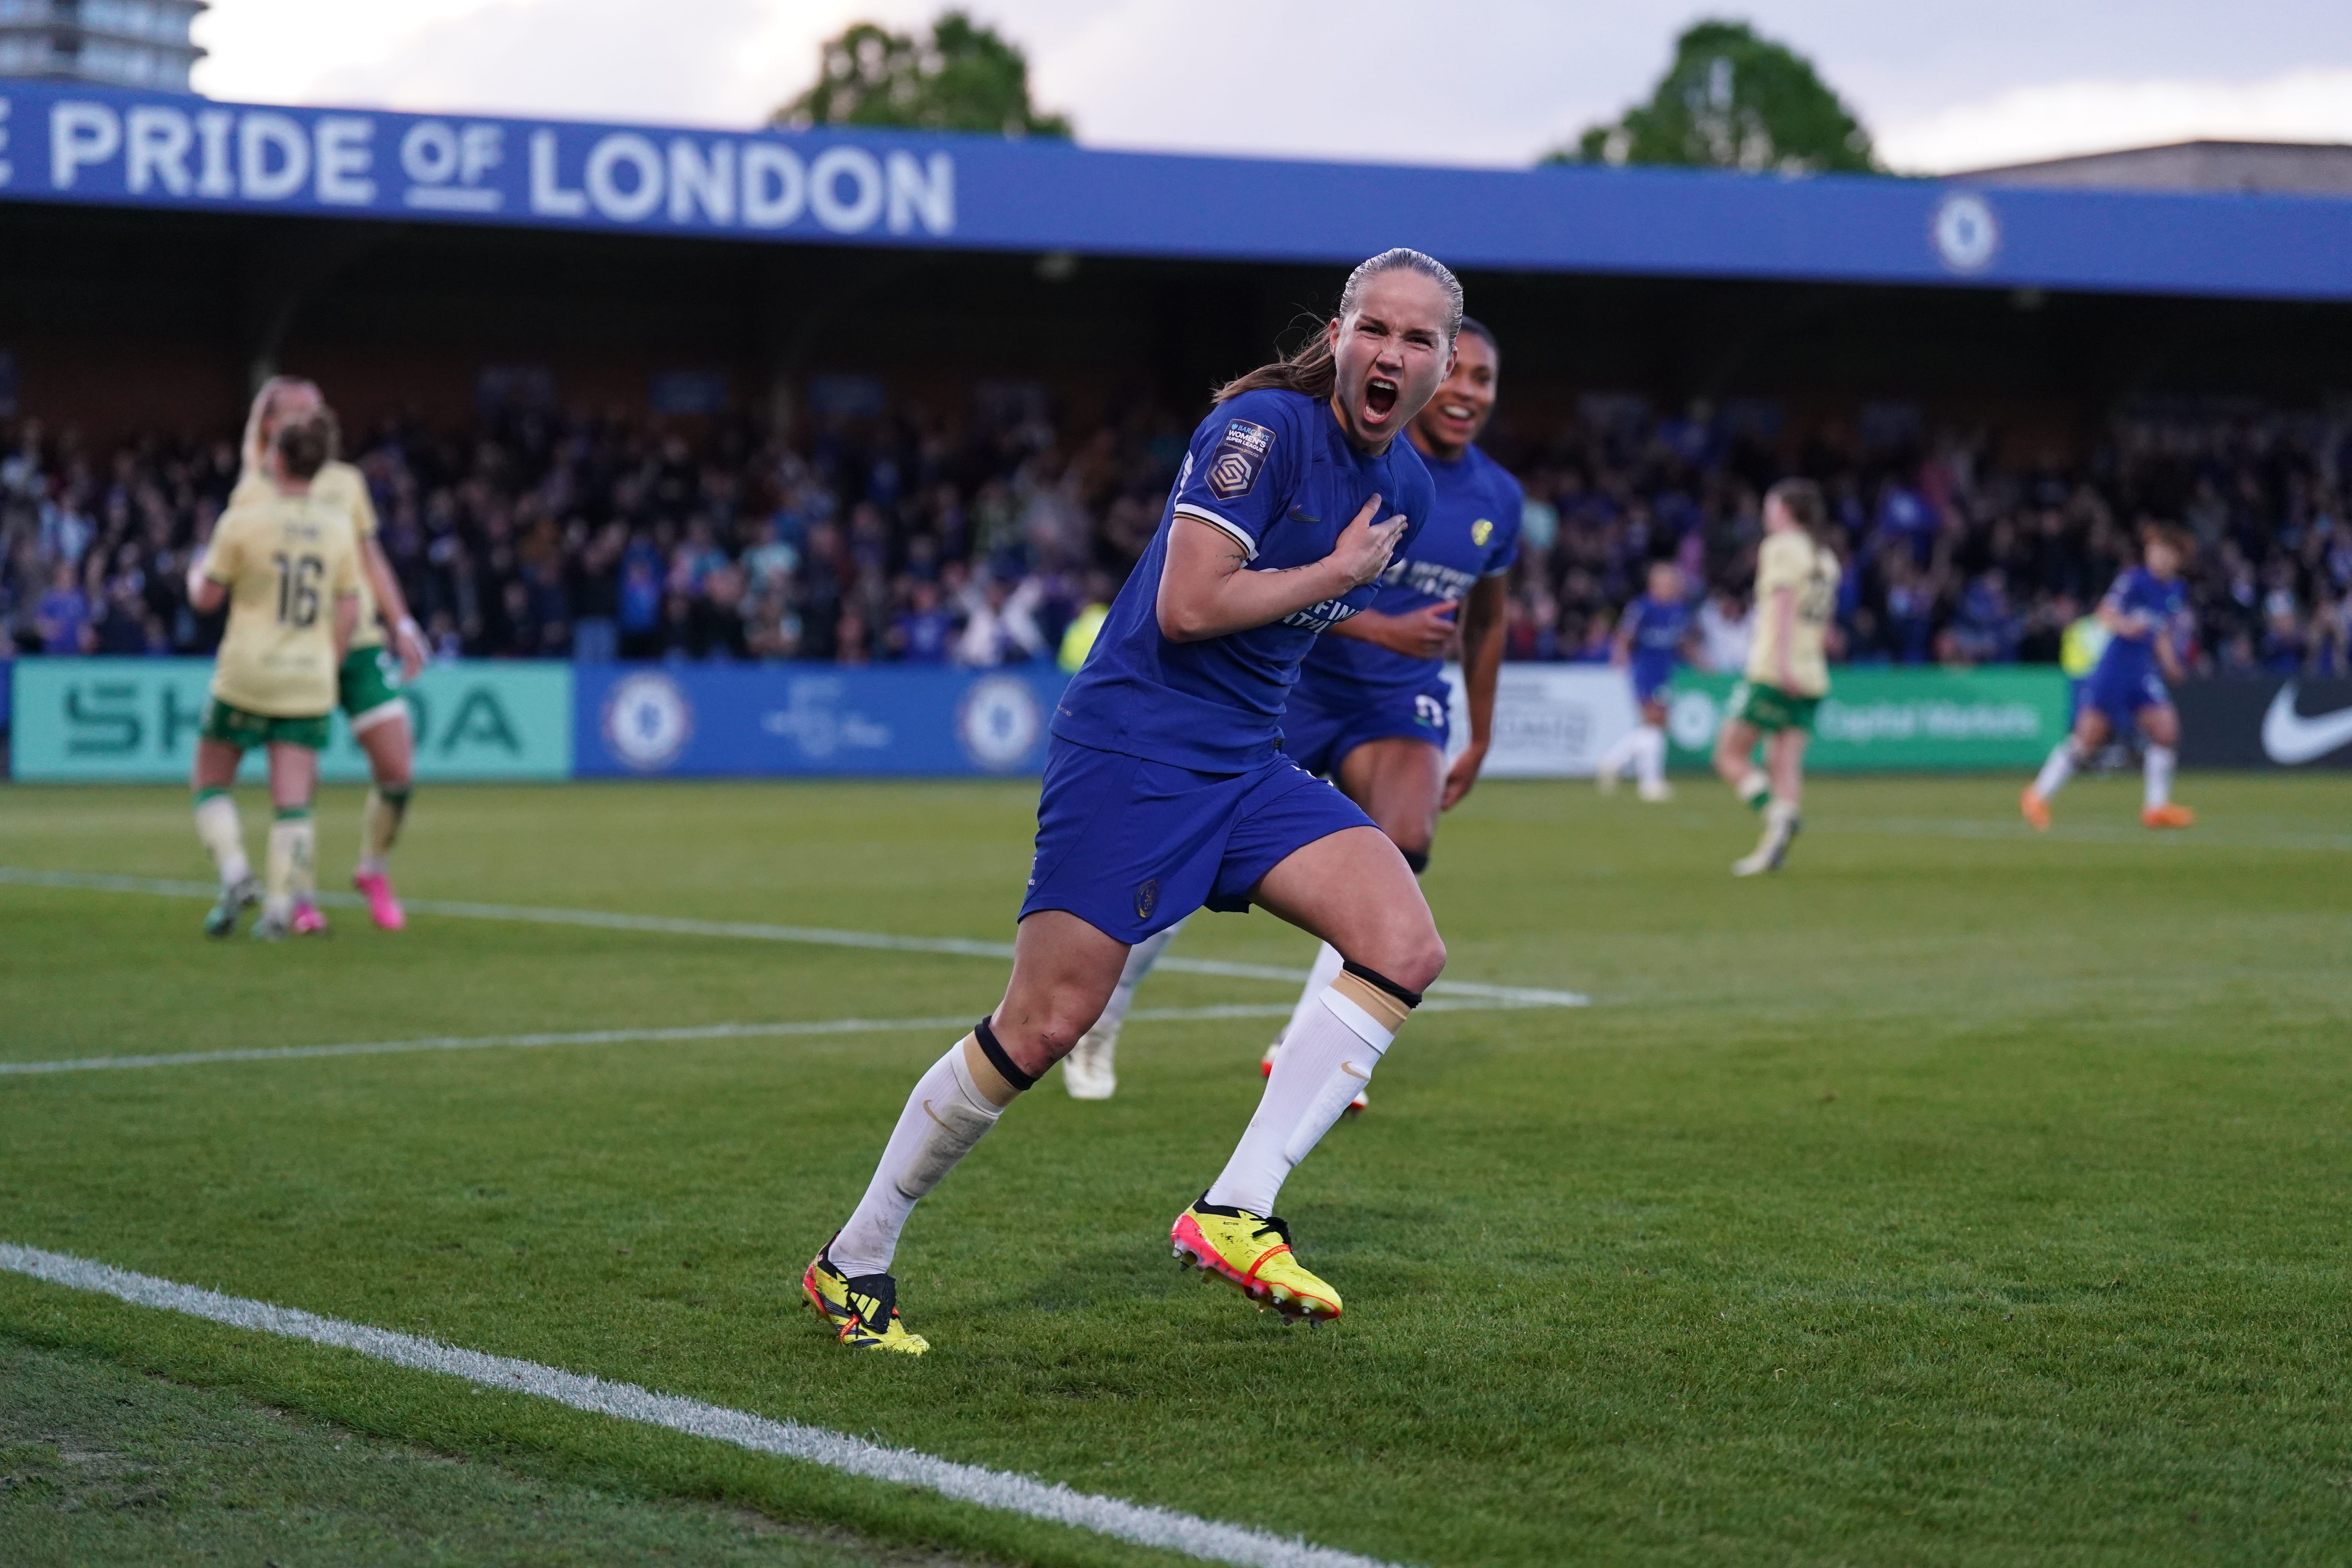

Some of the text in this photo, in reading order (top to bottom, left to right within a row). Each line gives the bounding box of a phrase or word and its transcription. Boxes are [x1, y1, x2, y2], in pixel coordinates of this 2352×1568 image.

[49, 100, 377, 205] PRIDE
[401, 120, 503, 184] OF
[530, 128, 956, 236] LONDON
[1229, 430, 1266, 448] WOMEN'S
[1238, 425, 1269, 441] BARCLAYS
[1242, 442, 1264, 453] LEAGUE
[272, 551, 324, 628] 16
